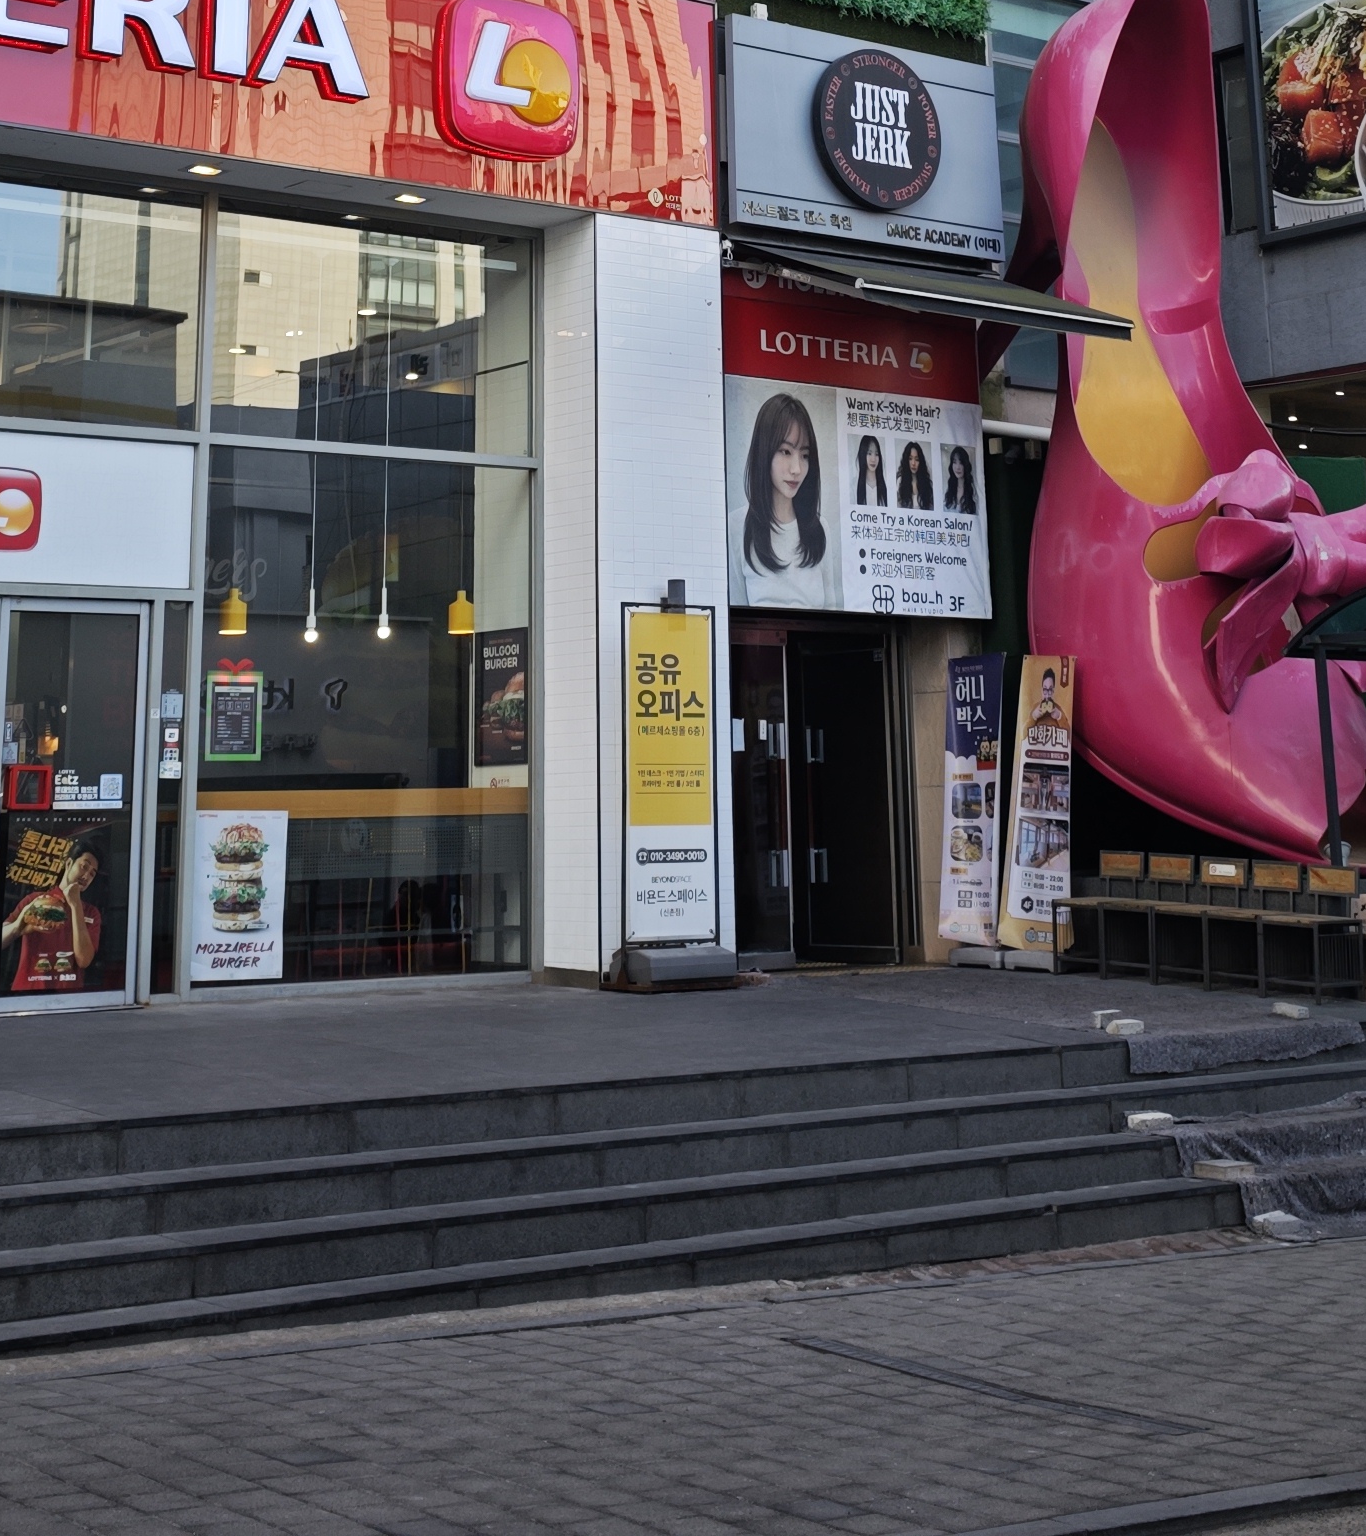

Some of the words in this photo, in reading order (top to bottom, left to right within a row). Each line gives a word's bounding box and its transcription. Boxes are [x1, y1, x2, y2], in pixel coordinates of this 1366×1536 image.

[852, 54, 906, 80] STRONGER
[825, 76, 842, 121] FASTER
[851, 81, 909, 128] JUST
[917, 93, 936, 139] POWER
[851, 123, 913, 169] JERK
[834, 148, 871, 195] HARDER
[887, 222, 921, 242] DANCE
[924, 226, 971, 249] ACADEMY
[975, 235, 1001, 254] (이대)
[760, 329, 899, 368] LOTTERIA
[846, 396, 874, 412] Want
[876, 399, 913, 417] K-Style
[915, 403, 941, 420] Hair?
[850, 510, 878, 525] Come
[881, 512, 896, 528] Try
[907, 514, 942, 530] Korean
[945, 517, 973, 532] Salon!
[870, 547, 922, 564] Foreigners
[924, 551, 967, 567] Welcome
[871, 563, 935, 581] 欢迎外国顾客
[902, 588, 943, 604] bau_h
[949, 596, 965, 612] 3F
[483, 644, 519, 658] BULGOGI
[485, 657, 517, 670] BURGER
[636, 653, 681, 686] 공유
[955, 674, 985, 703] 허니
[636, 689, 705, 722] 오피스
[956, 705, 987, 732] 박스
[1028, 724, 1068, 746] 만화카페
[650, 851, 705, 861] 010-3490-0018
[6, 865, 58, 887] 치킨버거
[636, 889, 707, 904] 비욘드스페이스
[196, 941, 274, 955] MOZZARELLA
[211, 956, 260, 969] BURGER
